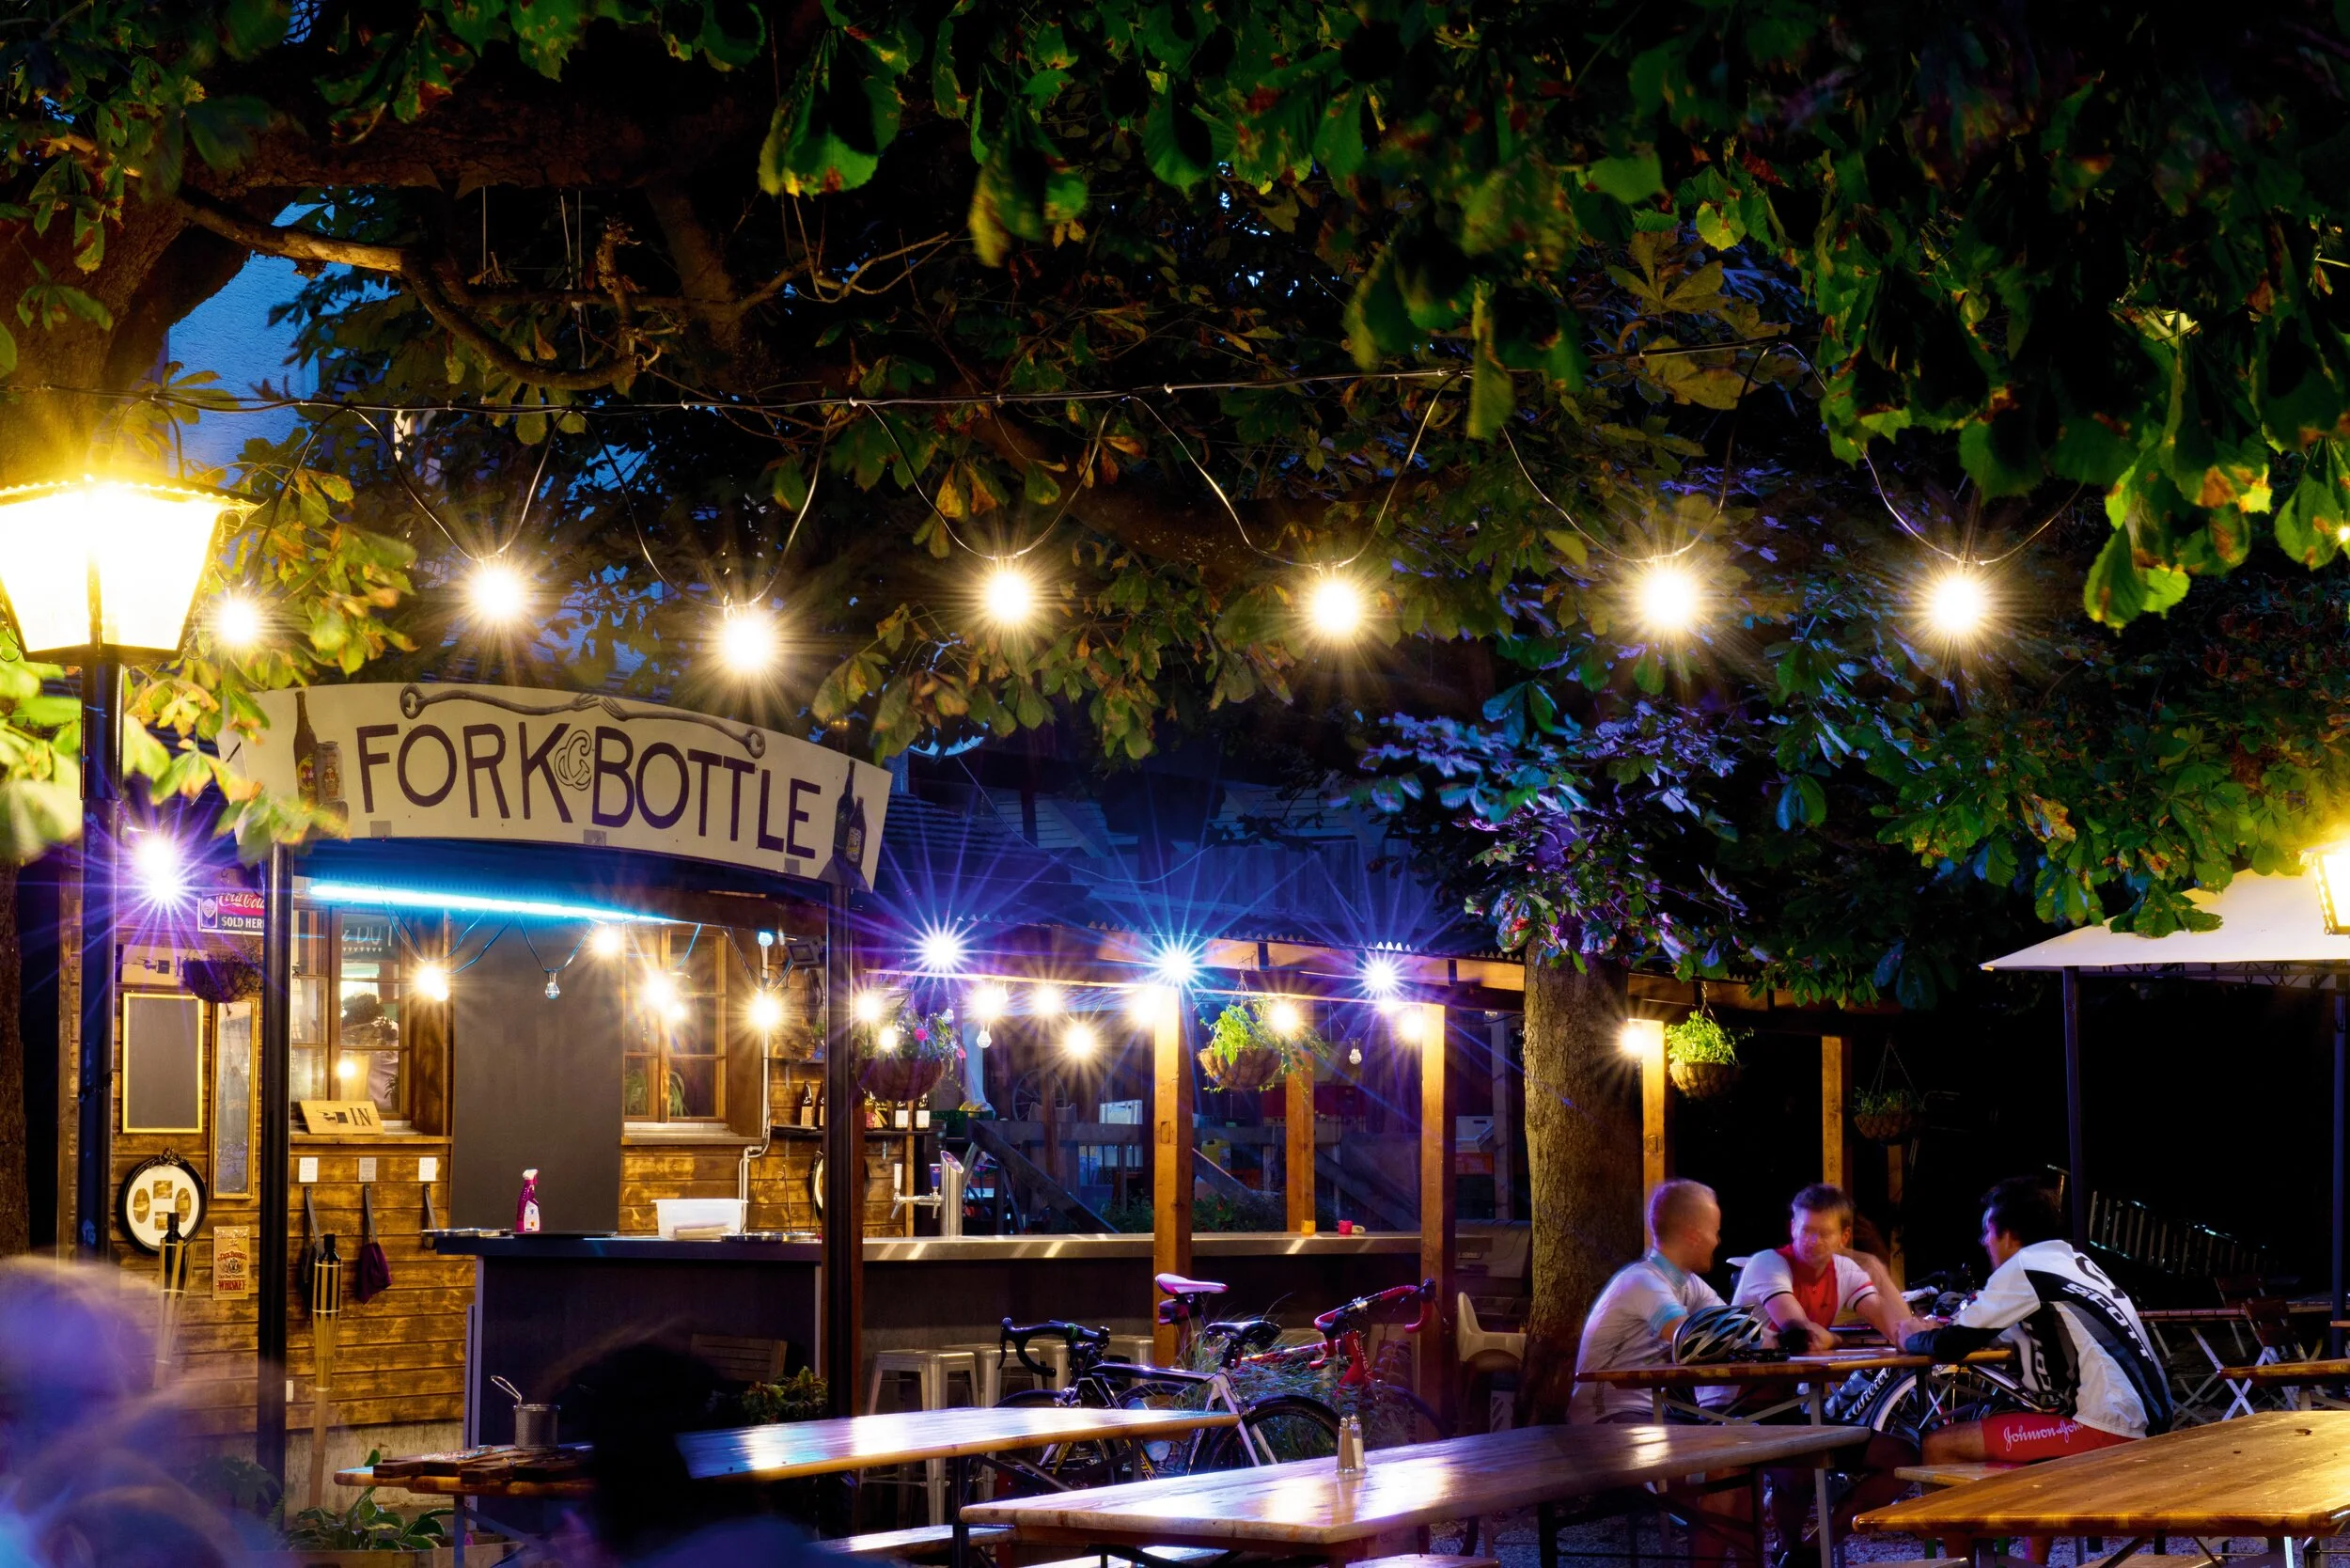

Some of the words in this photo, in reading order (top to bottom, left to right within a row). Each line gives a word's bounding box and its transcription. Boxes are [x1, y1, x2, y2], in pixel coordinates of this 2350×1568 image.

[356, 721, 574, 824] FORK
[591, 726, 823, 859] BOTTLE
[221, 916, 243, 928] SOLD
[245, 917, 265, 929] HER
[349, 1107, 373, 1127] IN
[218, 1279, 246, 1291] WHISKEY
[2061, 1283, 2153, 1362] SCOTT
[2003, 1424, 2057, 1452] Johnson
